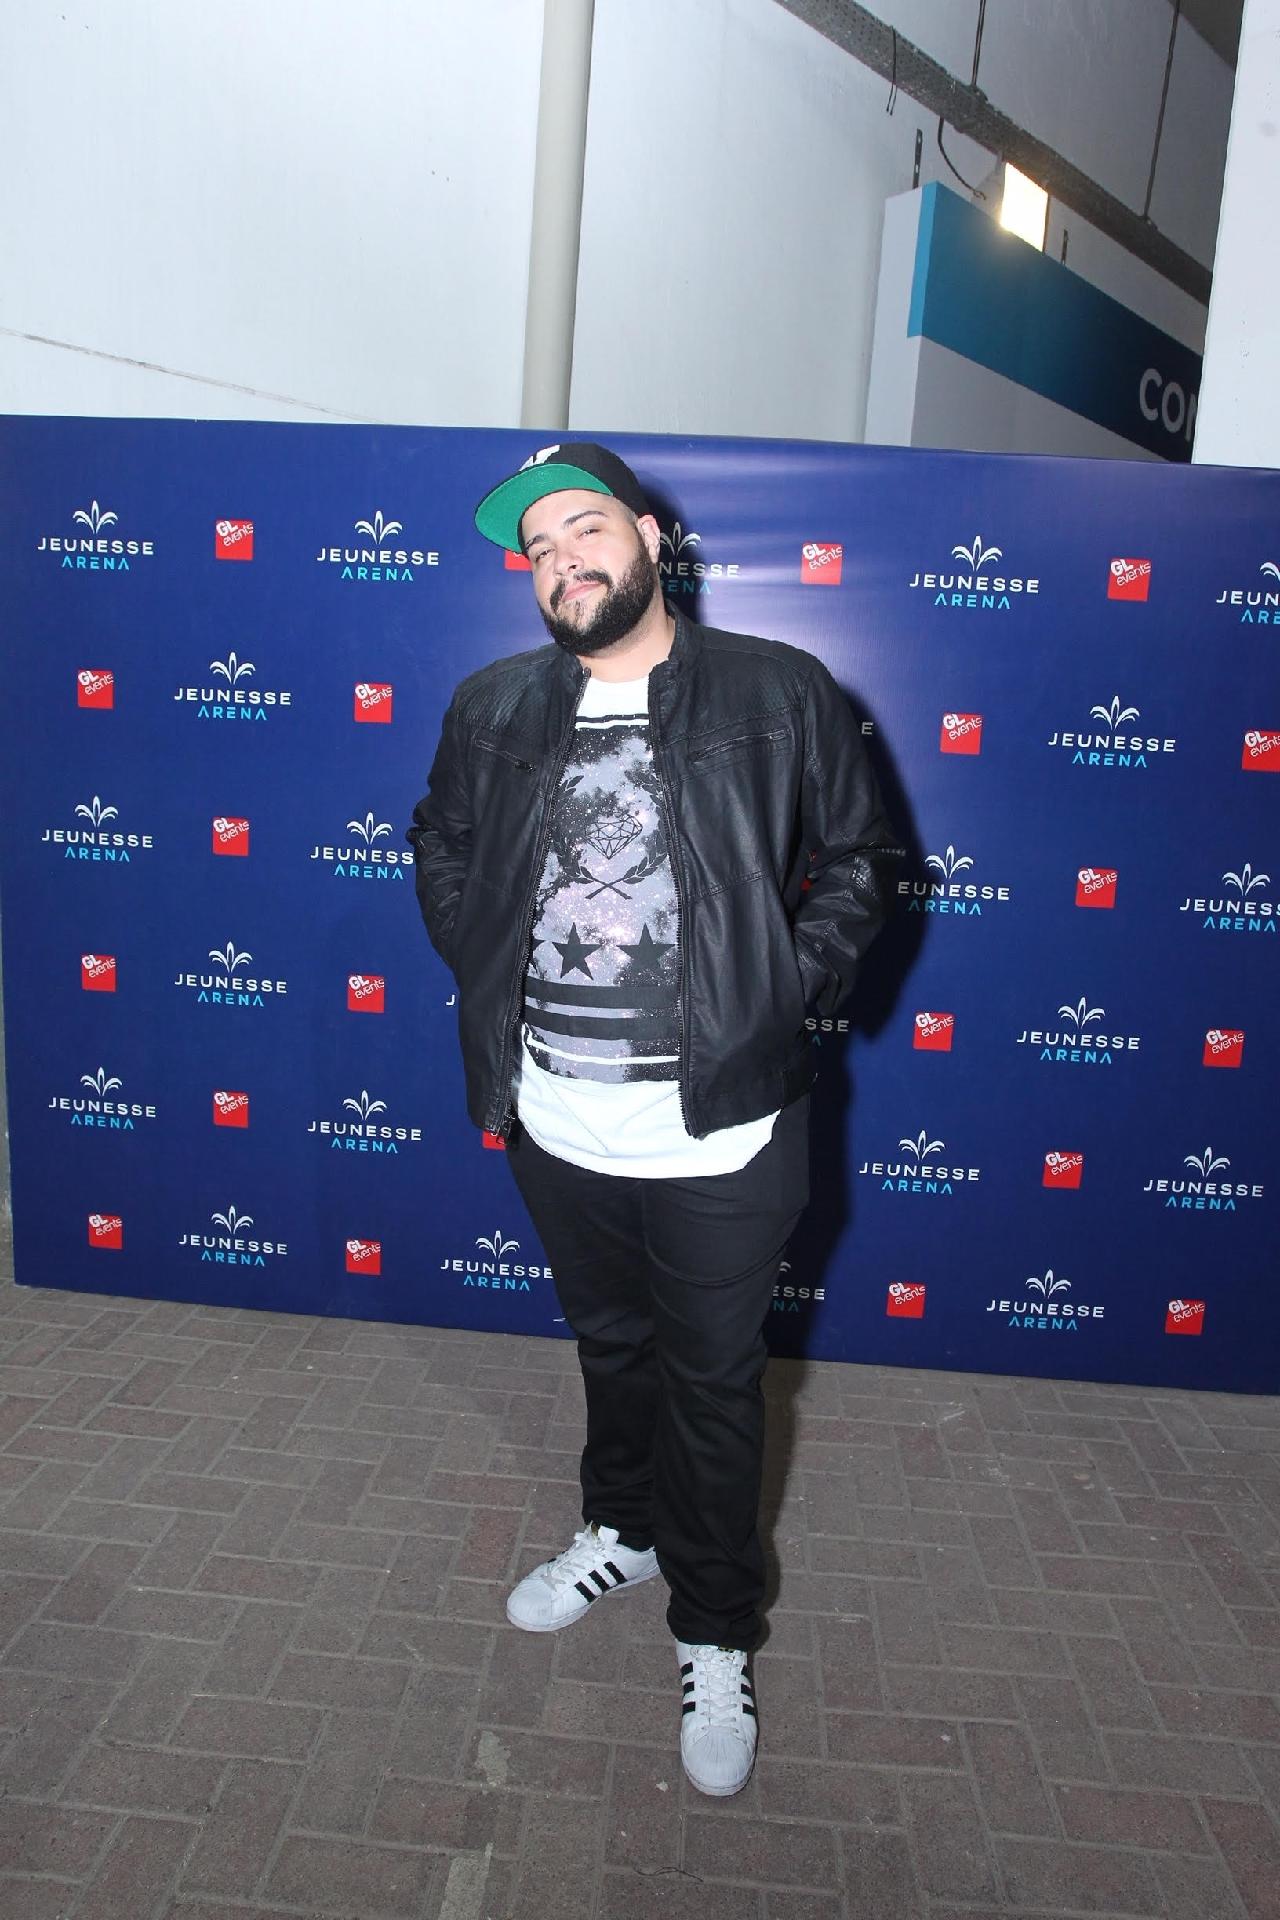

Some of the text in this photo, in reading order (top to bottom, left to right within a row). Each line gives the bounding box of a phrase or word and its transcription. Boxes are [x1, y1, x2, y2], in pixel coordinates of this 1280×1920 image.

[216, 521, 238, 536] GL
[224, 522, 253, 546] events
[38, 538, 153, 554] JEUNESSE
[803, 544, 826, 560] GL
[63, 556, 129, 570] ARENA
[317, 549, 438, 565] JEUNESSE
[809, 546, 842, 569] events
[341, 567, 413, 581] ARENA
[659, 562, 739, 577] NESSE
[1110, 559, 1133, 574] GL
[1117, 560, 1150, 586] events
[910, 574, 1038, 593] JEUNESSE
[935, 593, 1010, 609] ARENA
[1216, 590, 1280, 606] JEUN
[1240, 609, 1280, 625] ARE
[78, 671, 98, 686] GL
[85, 672, 114, 695] events
[175, 688, 290, 704] JEUNESSE
[355, 684, 376, 699] GL
[362, 686, 392, 709] events
[198, 705, 267, 720] ARENA
[943, 714, 965, 728] GL
[949, 715, 982, 739] events
[1049, 733, 1175, 751] JEUNESSE
[1245, 732, 1267, 746] GL
[1072, 751, 1146, 768] ARENA
[213, 818, 234, 833] GL
[220, 821, 249, 842] events
[42, 830, 152, 847] JEUNESSE
[66, 847, 129, 862] ARENA
[310, 846, 414, 865] JEUNESS
[335, 864, 403, 879] ARENA
[1078, 869, 1100, 883] GL
[898, 881, 1010, 900] EUNESSE
[1084, 871, 1117, 894] events
[907, 899, 982, 915] ARENA
[1179, 898, 1280, 916] JEUNES
[1204, 917, 1275, 931] ARENA
[82, 955, 102, 970] GL
[88, 957, 116, 978] events
[175, 974, 286, 991] JEUNESSE
[348, 976, 369, 990] GL
[355, 978, 384, 998] events
[198, 991, 264, 1006] ARENA
[916, 1013, 938, 1027] GL
[921, 1014, 953, 1037] events
[1017, 1031, 1139, 1049] JEUNESSE
[1206, 1030, 1228, 1044] GL
[1212, 1032, 1244, 1054] events
[1041, 1049, 1111, 1063] ARENA
[214, 1092, 234, 1106] GL
[220, 1094, 248, 1114] events
[49, 1098, 155, 1117] JEUNESSE
[71, 1114, 134, 1129] ARENA
[308, 1122, 421, 1140] JEUNESSE
[331, 1138, 398, 1153] ARENA
[1046, 1152, 1067, 1166] GL
[1052, 1154, 1082, 1175] events
[860, 1163, 979, 1180] JEUNESSE
[882, 1180, 952, 1194] ARENA
[1144, 1180, 1263, 1196] JEUNESSE
[1165, 1196, 1236, 1211] ARENA
[88, 1214, 107, 1227] GL
[96, 1216, 122, 1236] events
[179, 1235, 286, 1254] JEUNESSE
[346, 1240, 366, 1253] GL
[353, 1243, 381, 1262] events
[202, 1251, 264, 1265] ARENA
[441, 1260, 553, 1278] JEUNESSE
[463, 1276, 529, 1291] ARENA
[889, 1282, 910, 1296] GL
[895, 1285, 925, 1305] events
[987, 1300, 1104, 1317] JEUNESSE
[1168, 1300, 1189, 1314] GL
[1174, 1303, 1204, 1322] events
[1008, 1316, 1078, 1331] ARENA
